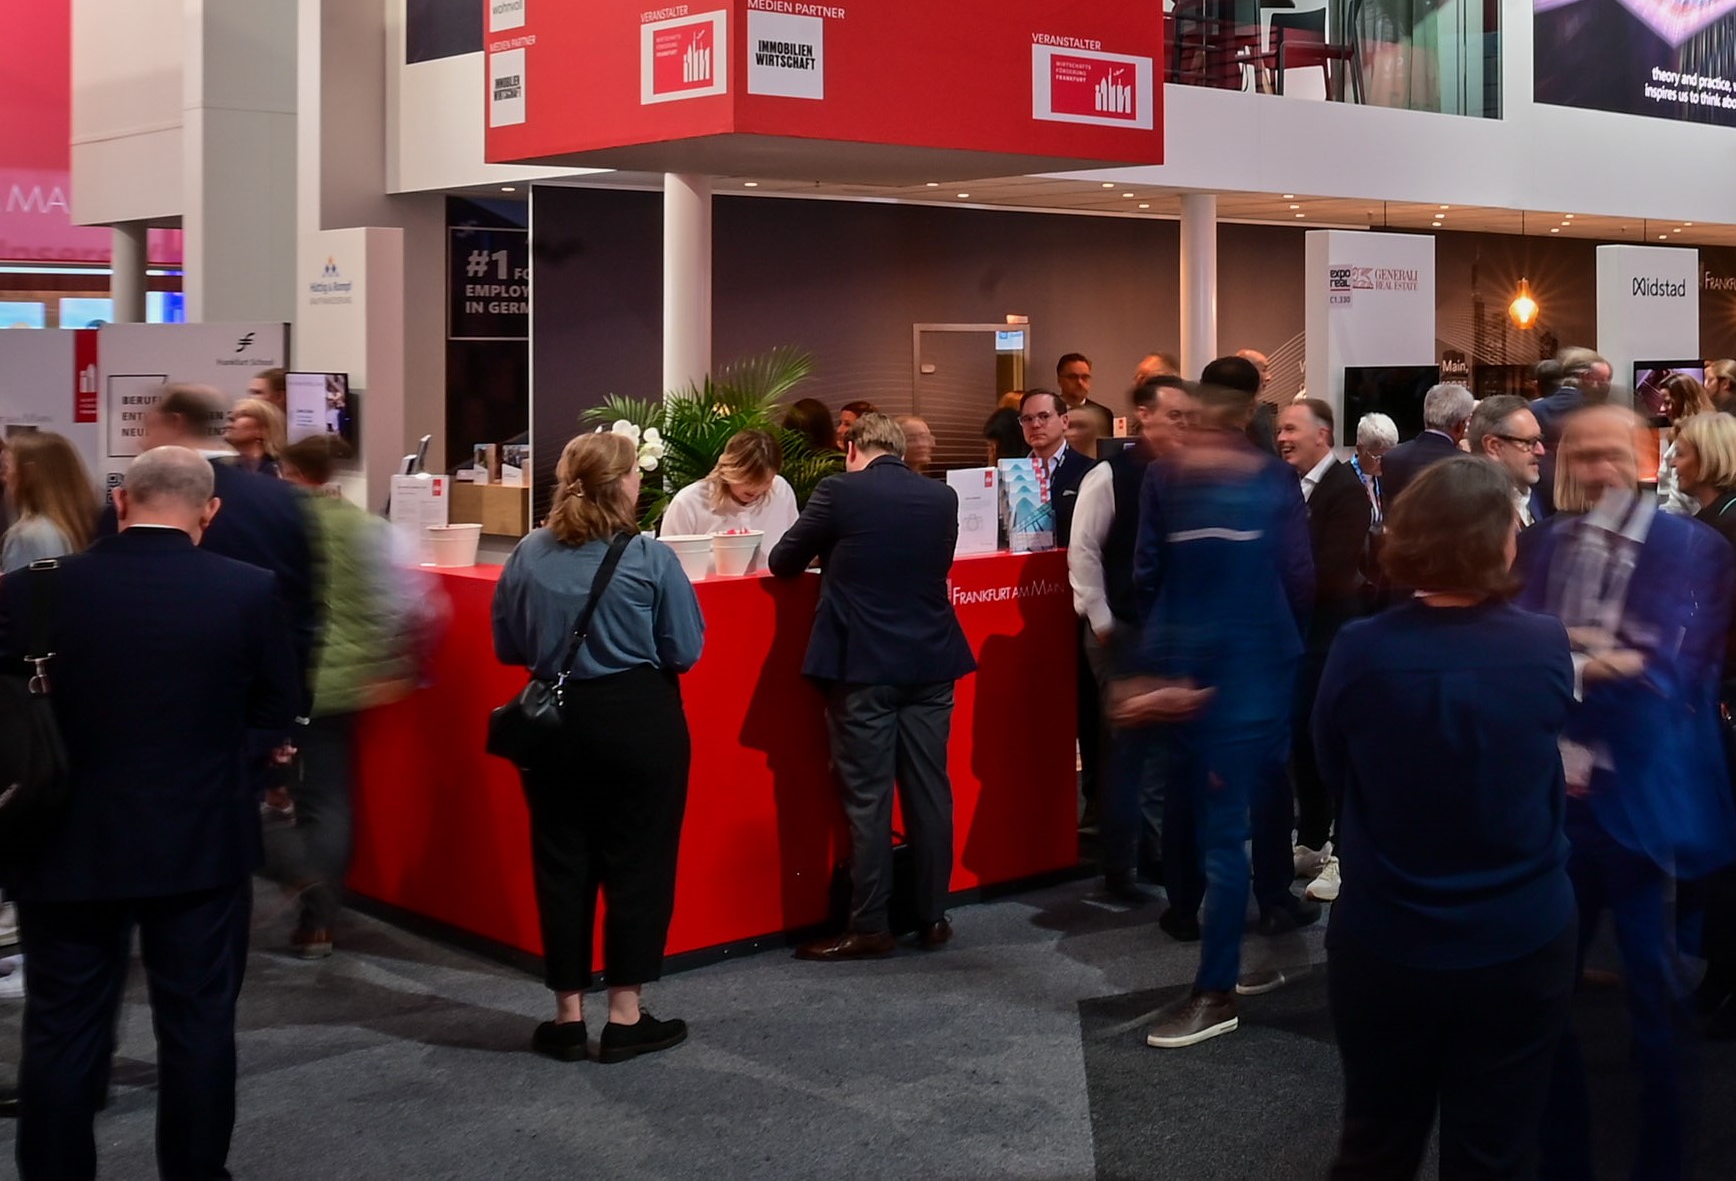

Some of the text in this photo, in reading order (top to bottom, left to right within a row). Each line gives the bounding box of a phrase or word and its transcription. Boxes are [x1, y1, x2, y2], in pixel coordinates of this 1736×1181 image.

[641, 5, 688, 23] VERANSTALTER
[795, 3, 844, 18] PARTNER
[758, 40, 812, 57] IMMOBILIEN
[1032, 33, 1101, 50] VERANSTALTER
[756, 53, 815, 70] WIRTSCHAFT
[1652, 66, 1680, 87] theory
[1681, 73, 1697, 86] and
[1645, 83, 1677, 102] inspires
[1678, 91, 1688, 102] us
[1690, 90, 1698, 104] to
[1700, 91, 1720, 107] think
[467, 250, 507, 279] #1
[1330, 270, 1350, 280] expo
[1375, 269, 1417, 281] GENERALI
[466, 302, 483, 313] IN
[1442, 360, 1468, 373] Main,
[953, 587, 1011, 605] FRANKFURT
